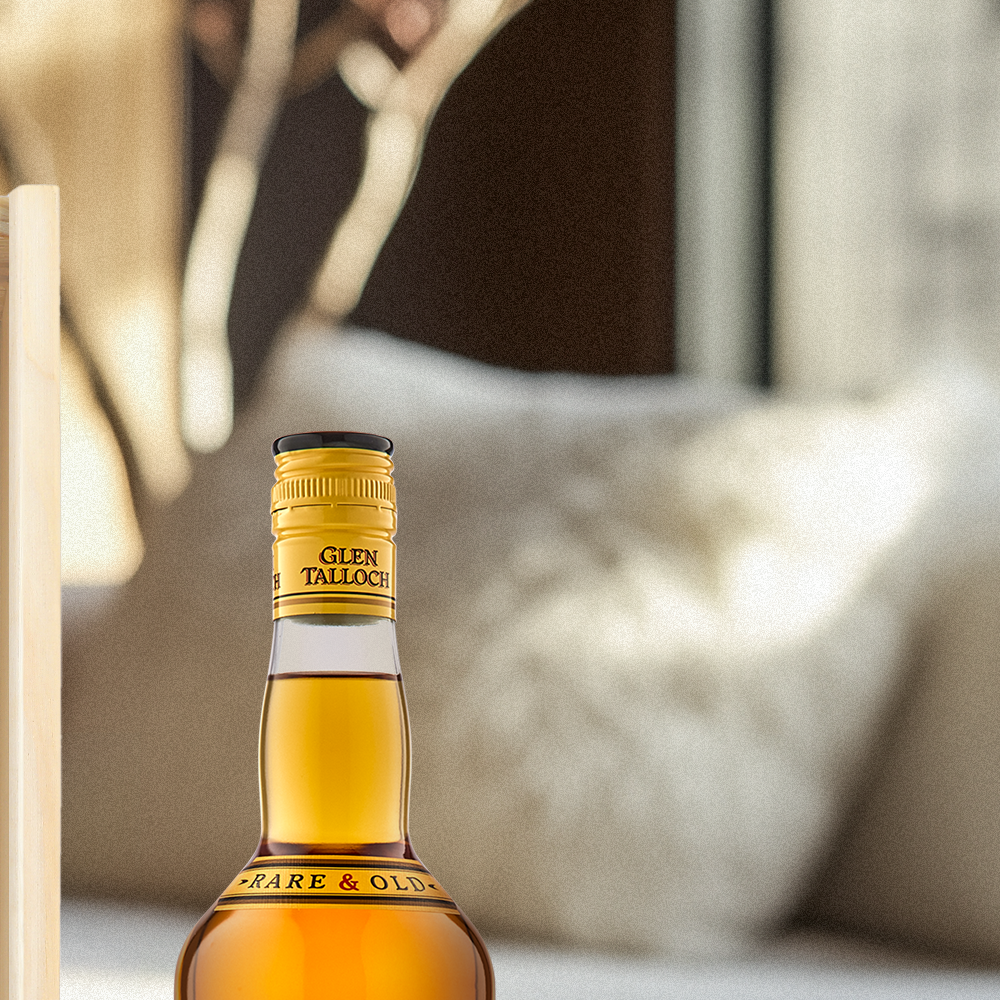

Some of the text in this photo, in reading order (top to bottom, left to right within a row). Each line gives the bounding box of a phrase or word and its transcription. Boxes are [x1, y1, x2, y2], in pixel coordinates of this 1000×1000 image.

[318, 546, 379, 567] GLEN
[300, 567, 390, 589] TALLOCH
[248, 873, 427, 892] RARE & OLD
